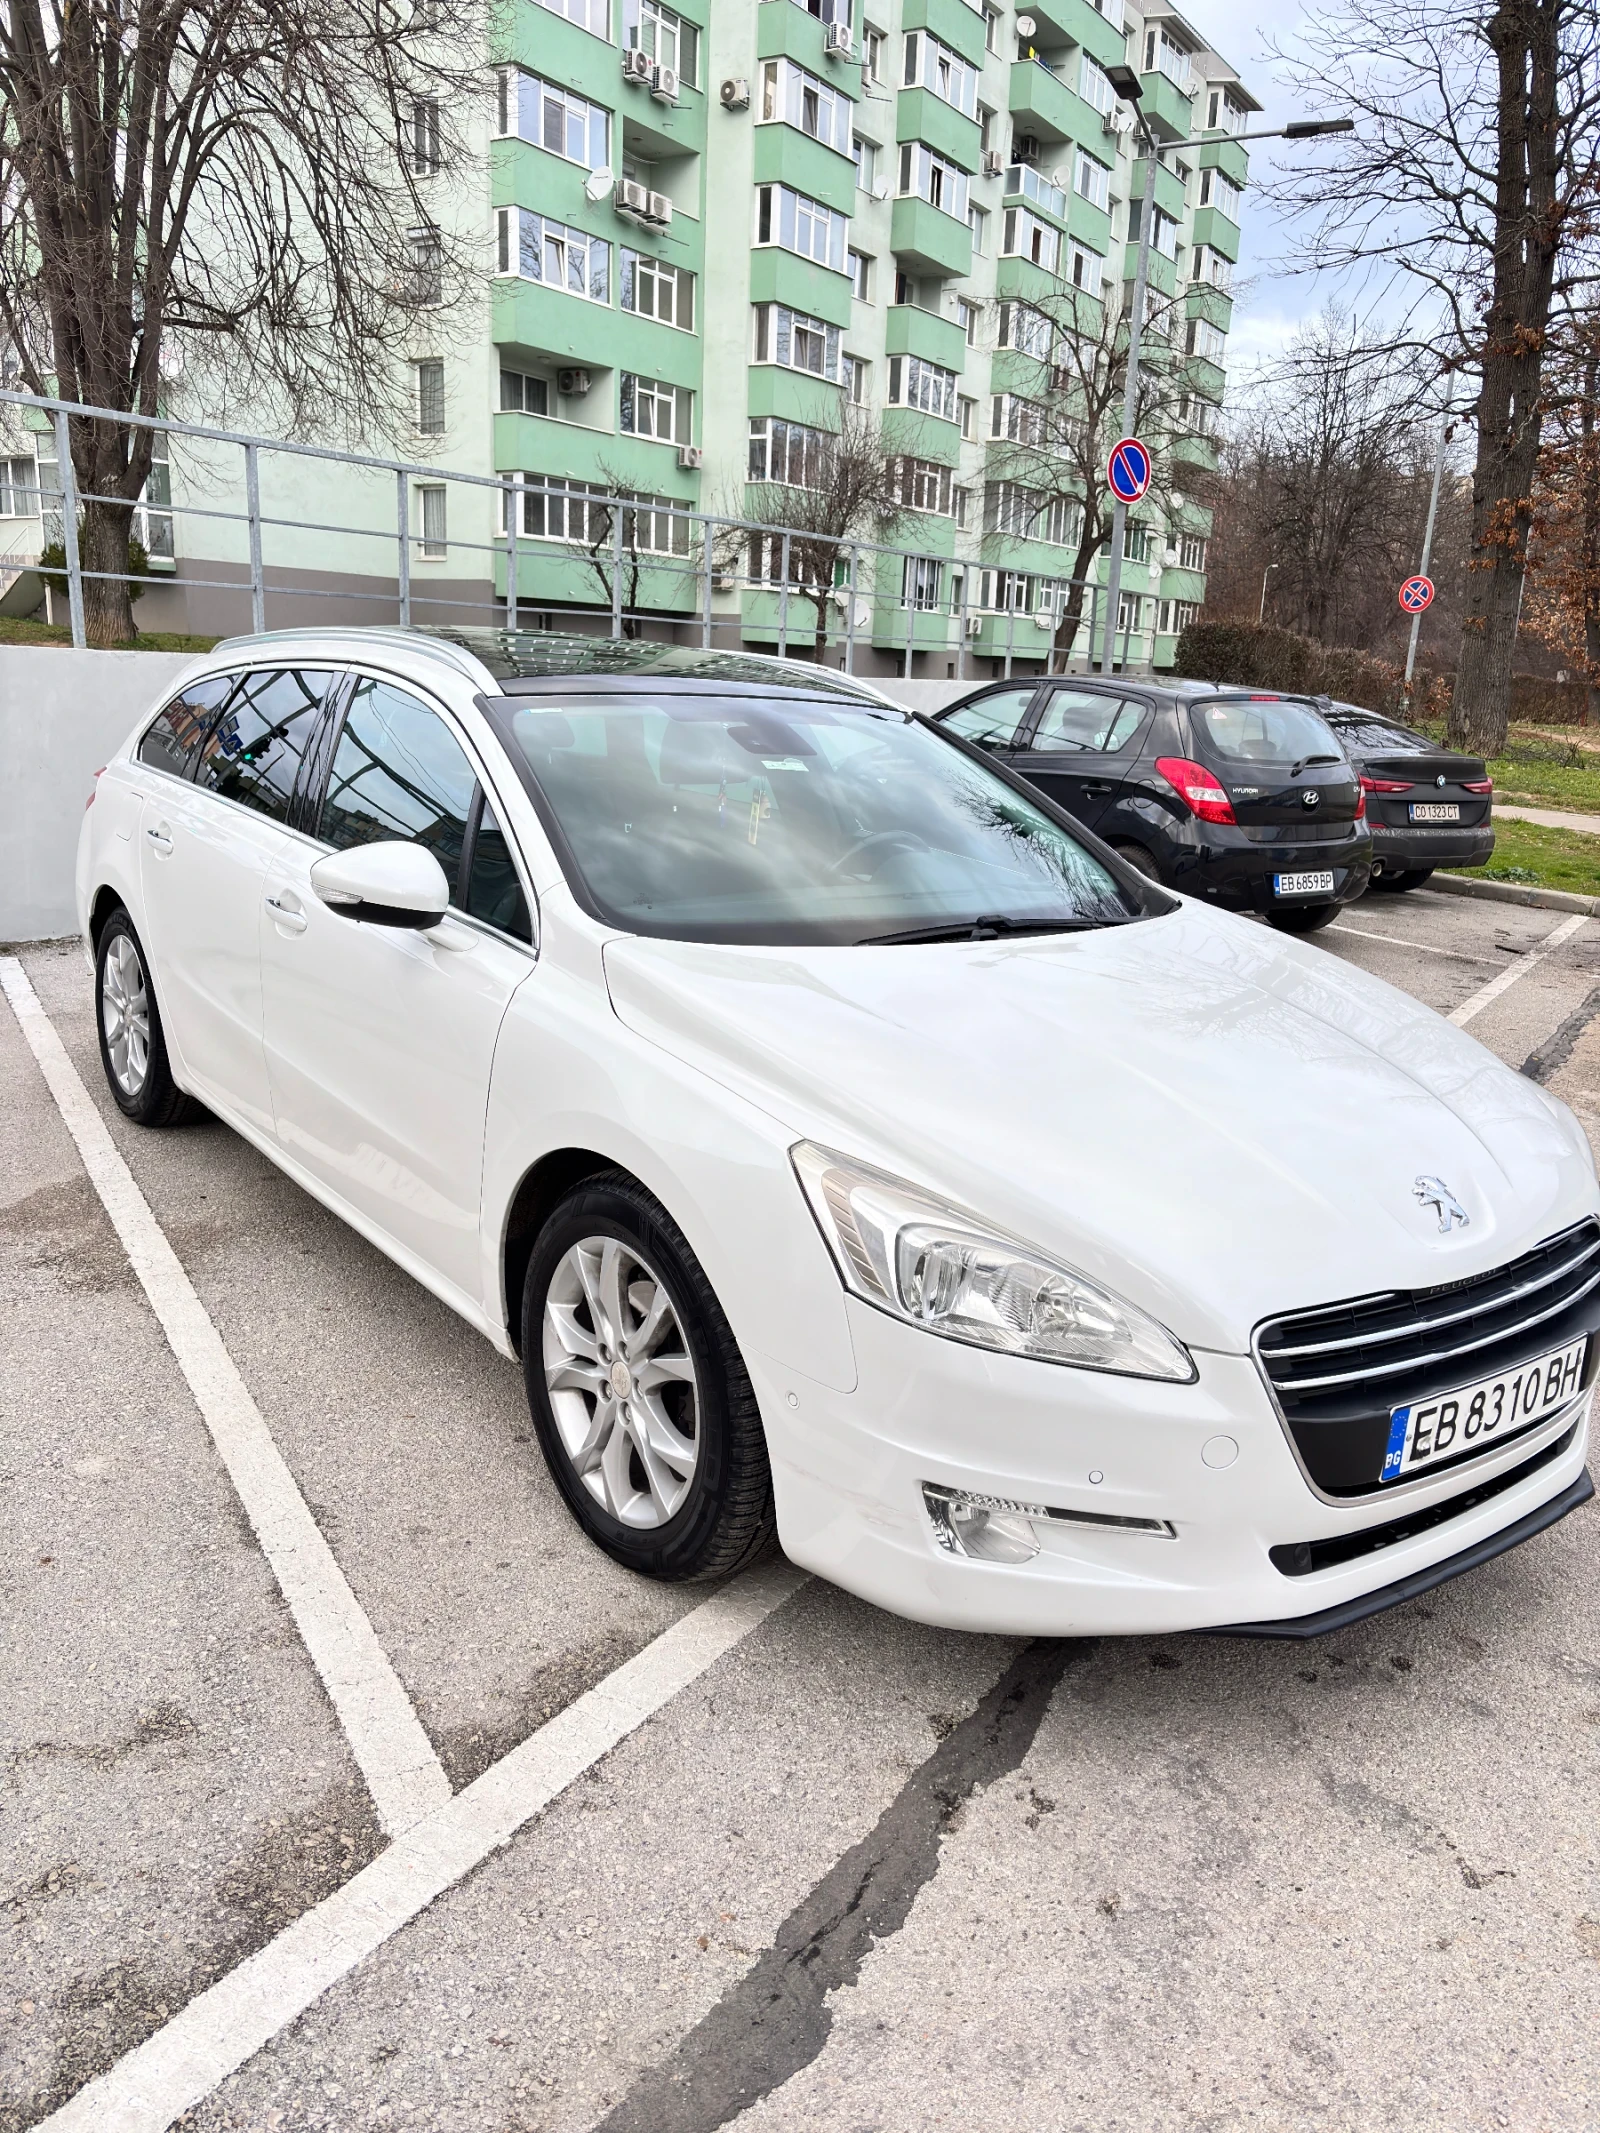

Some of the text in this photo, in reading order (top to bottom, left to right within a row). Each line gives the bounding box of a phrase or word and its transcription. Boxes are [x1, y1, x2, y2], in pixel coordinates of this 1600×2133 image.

[1428, 805, 1446, 818] 1323
[1447, 805, 1458, 818] CT
[1281, 874, 1331, 891] EB 6859 BP
[1408, 1347, 1582, 1462] EB 8310 BH
[1385, 1451, 1401, 1468] BG
